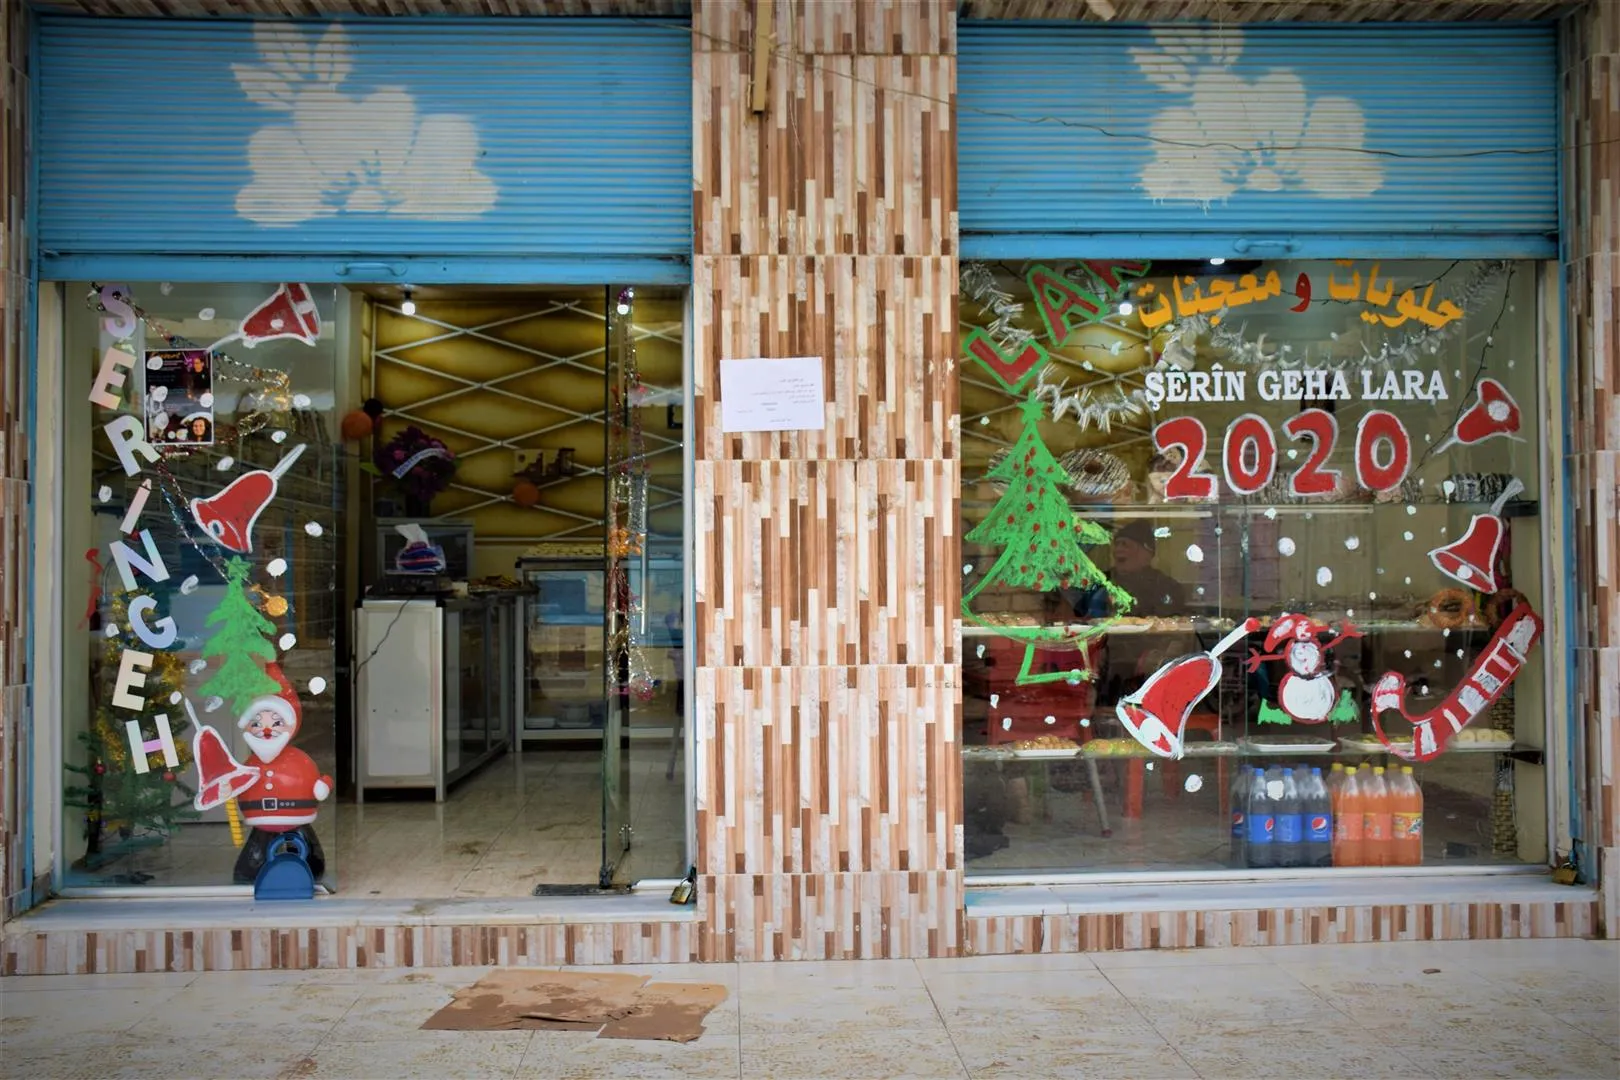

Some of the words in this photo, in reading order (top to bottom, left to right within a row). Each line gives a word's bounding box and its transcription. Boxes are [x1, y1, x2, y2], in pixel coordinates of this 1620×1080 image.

[1136, 269, 1282, 329] معجنات
[1288, 272, 1312, 313] و
[1328, 259, 1464, 330] حلويات
[1257, 370, 1352, 401] GEHA
[1361, 369, 1449, 401] LARA
[1151, 407, 1412, 500] 2020
